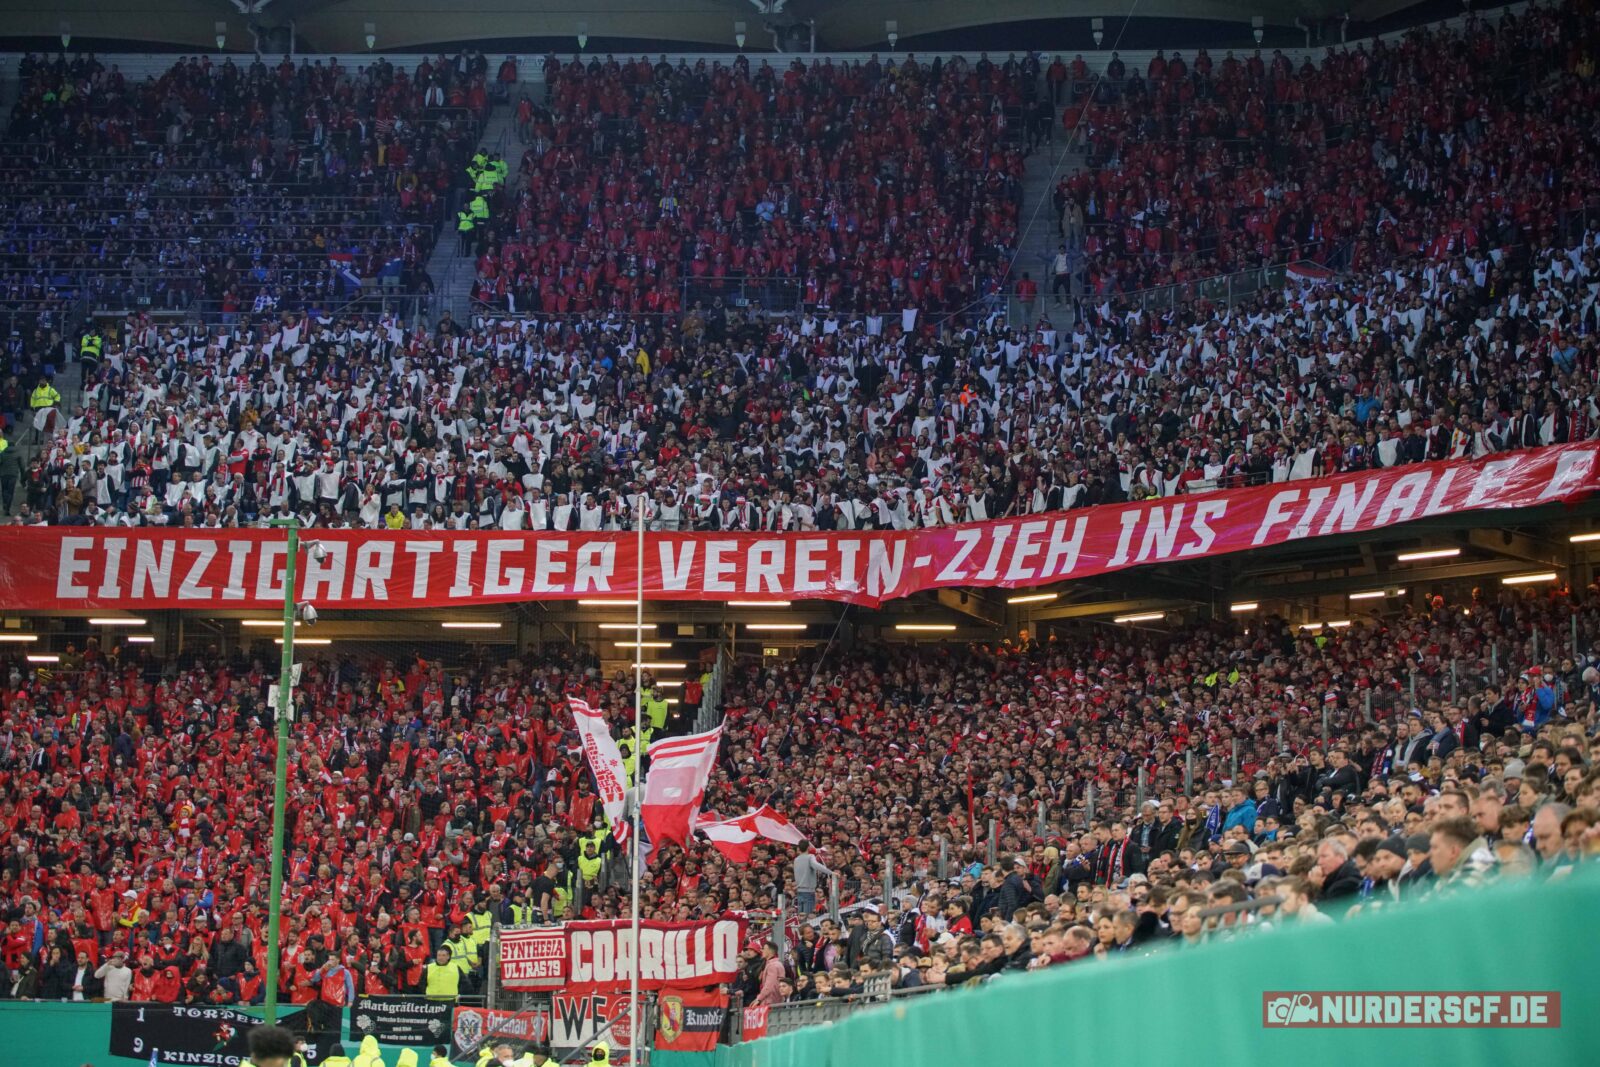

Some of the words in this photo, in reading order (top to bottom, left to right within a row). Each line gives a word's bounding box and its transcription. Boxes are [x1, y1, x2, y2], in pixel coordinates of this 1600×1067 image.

[56, 536, 616, 600] EINZIGARTIGER
[1106, 499, 1229, 567] INS
[1251, 454, 1525, 545] FINALE
[502, 939, 564, 959] SYNTHESIA
